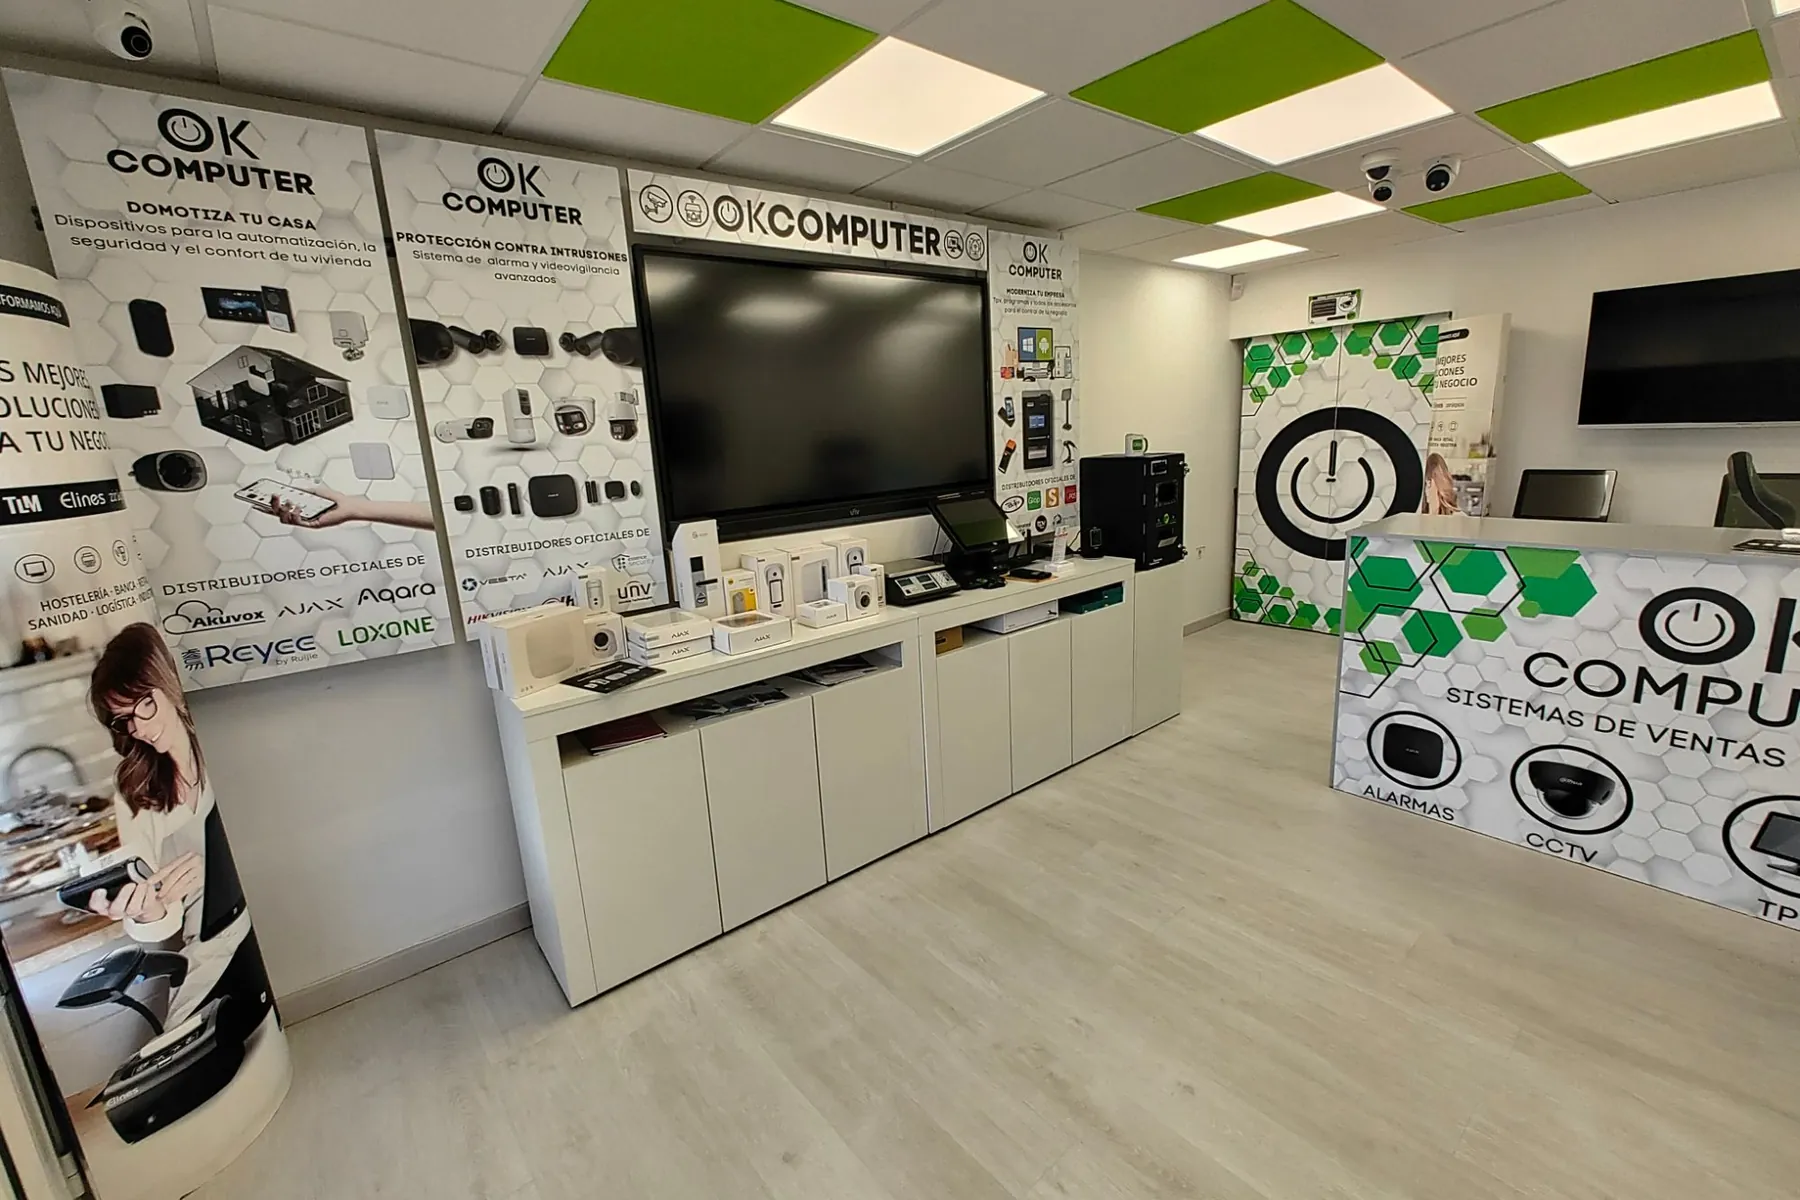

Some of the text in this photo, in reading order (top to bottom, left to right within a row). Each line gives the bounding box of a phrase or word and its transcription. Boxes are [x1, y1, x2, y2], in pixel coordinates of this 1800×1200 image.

[157, 108, 260, 160] OK
[106, 149, 316, 196] COMPUTER
[477, 157, 546, 198] OK
[126, 201, 317, 231] DOMOTIZA TU CASA
[442, 192, 583, 226] COMPUTER
[54, 212, 377, 254] Dispositivos para la automatización, la
[396, 231, 628, 262] PROTECCIÓN CONTRA INTRUSIONES
[70, 234, 372, 268] seguridad y el confort de tu vivienda
[412, 250, 620, 275] Sistema de alarma y videovigilancia
[1023, 241, 1048, 264] OK
[494, 272, 557, 285] avanzados
[1008, 264, 1062, 280] COMPUTER
[25, 430, 64, 452] TU
[2, 494, 42, 515] TLM
[60, 491, 106, 509] Elines
[465, 528, 650, 559] DISTRIBUIDORES OFICIALES DE
[162, 568, 316, 596] DISTRIBUIDORES
[320, 557, 404, 576] OFICIALES
[406, 555, 426, 566] DE
[40, 587, 111, 612] HOSTELERÍA
[278, 597, 344, 618] AJAX
[357, 582, 436, 606] Aqara
[28, 609, 88, 631] SANIDAD
[191, 610, 265, 629] Akuvox
[337, 616, 435, 647] LOXONE
[275, 651, 319, 667] by Ruijie
[1446, 687, 1787, 769] SISTEMAS DE VENTAS
[1363, 783, 1456, 823] ALARMAS
[1525, 832, 1599, 864] CCTV
